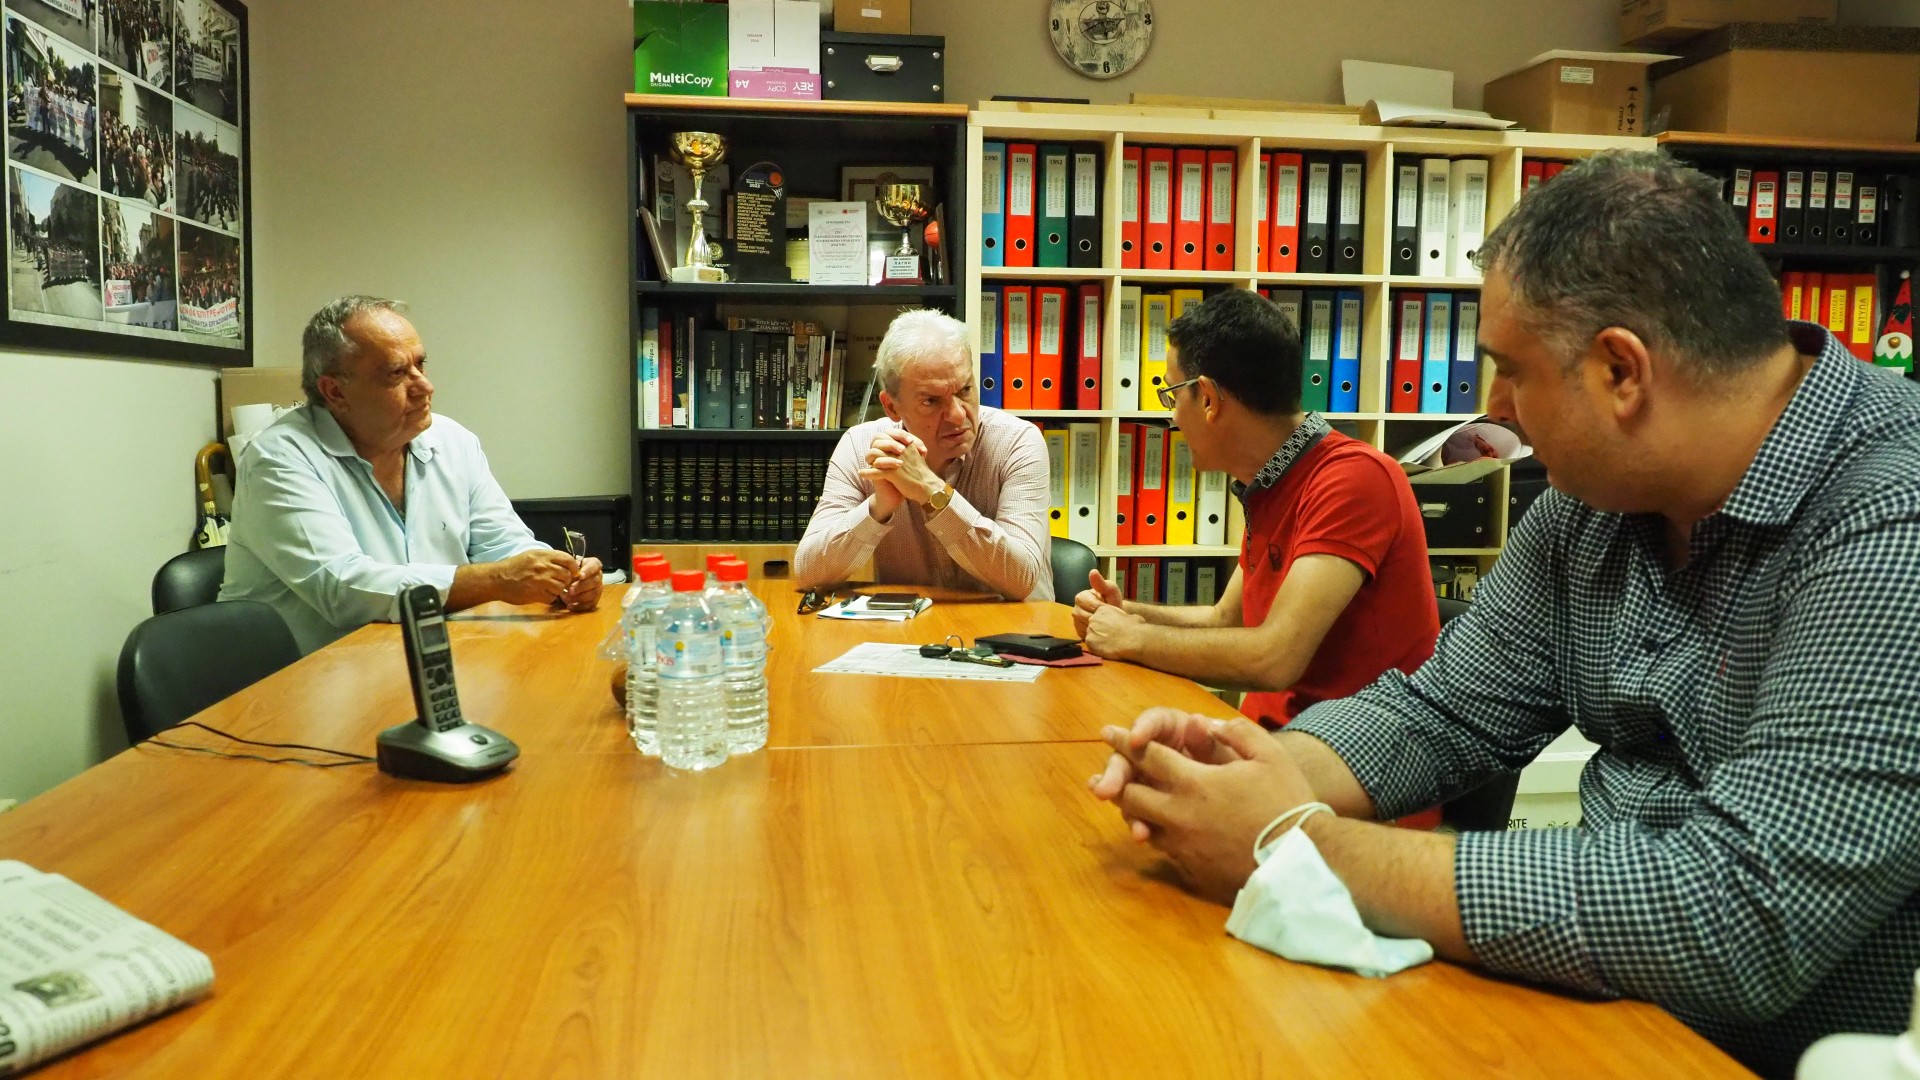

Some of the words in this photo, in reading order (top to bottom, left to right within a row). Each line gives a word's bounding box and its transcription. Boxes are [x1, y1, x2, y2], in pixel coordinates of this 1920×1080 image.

[1052, 19, 1059, 31] 9
[1144, 13, 1152, 26] 3
[1103, 61, 1110, 73] 6
[650, 72, 713, 87] MultiCopy
[735, 80, 750, 88] A4
[793, 82, 814, 91] REY
[1858, 298, 1866, 332] ΕΝΤΥΠΑ
